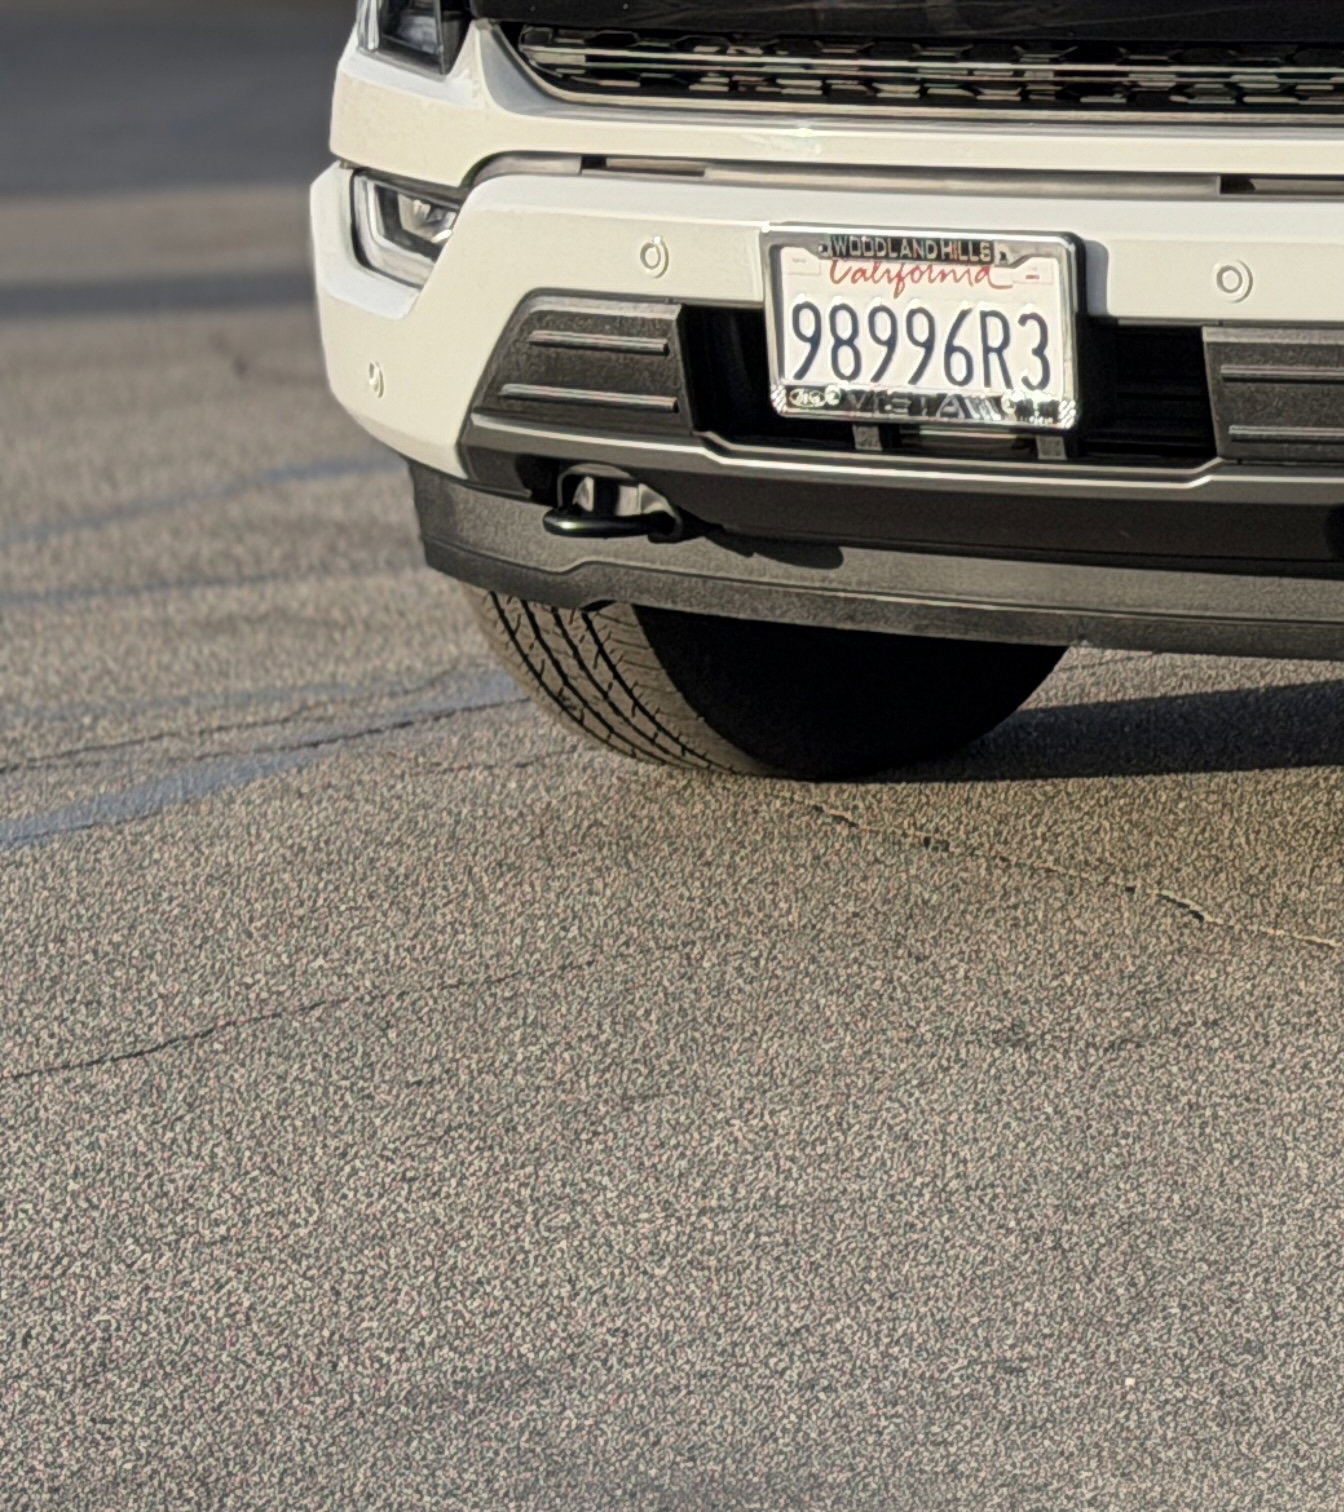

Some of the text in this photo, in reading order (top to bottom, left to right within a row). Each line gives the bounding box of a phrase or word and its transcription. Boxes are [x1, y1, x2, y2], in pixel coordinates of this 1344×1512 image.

[831, 235, 992, 263] WOODLAND HILLS
[829, 259, 1013, 299] California
[791, 300, 1052, 392] 98996R3
